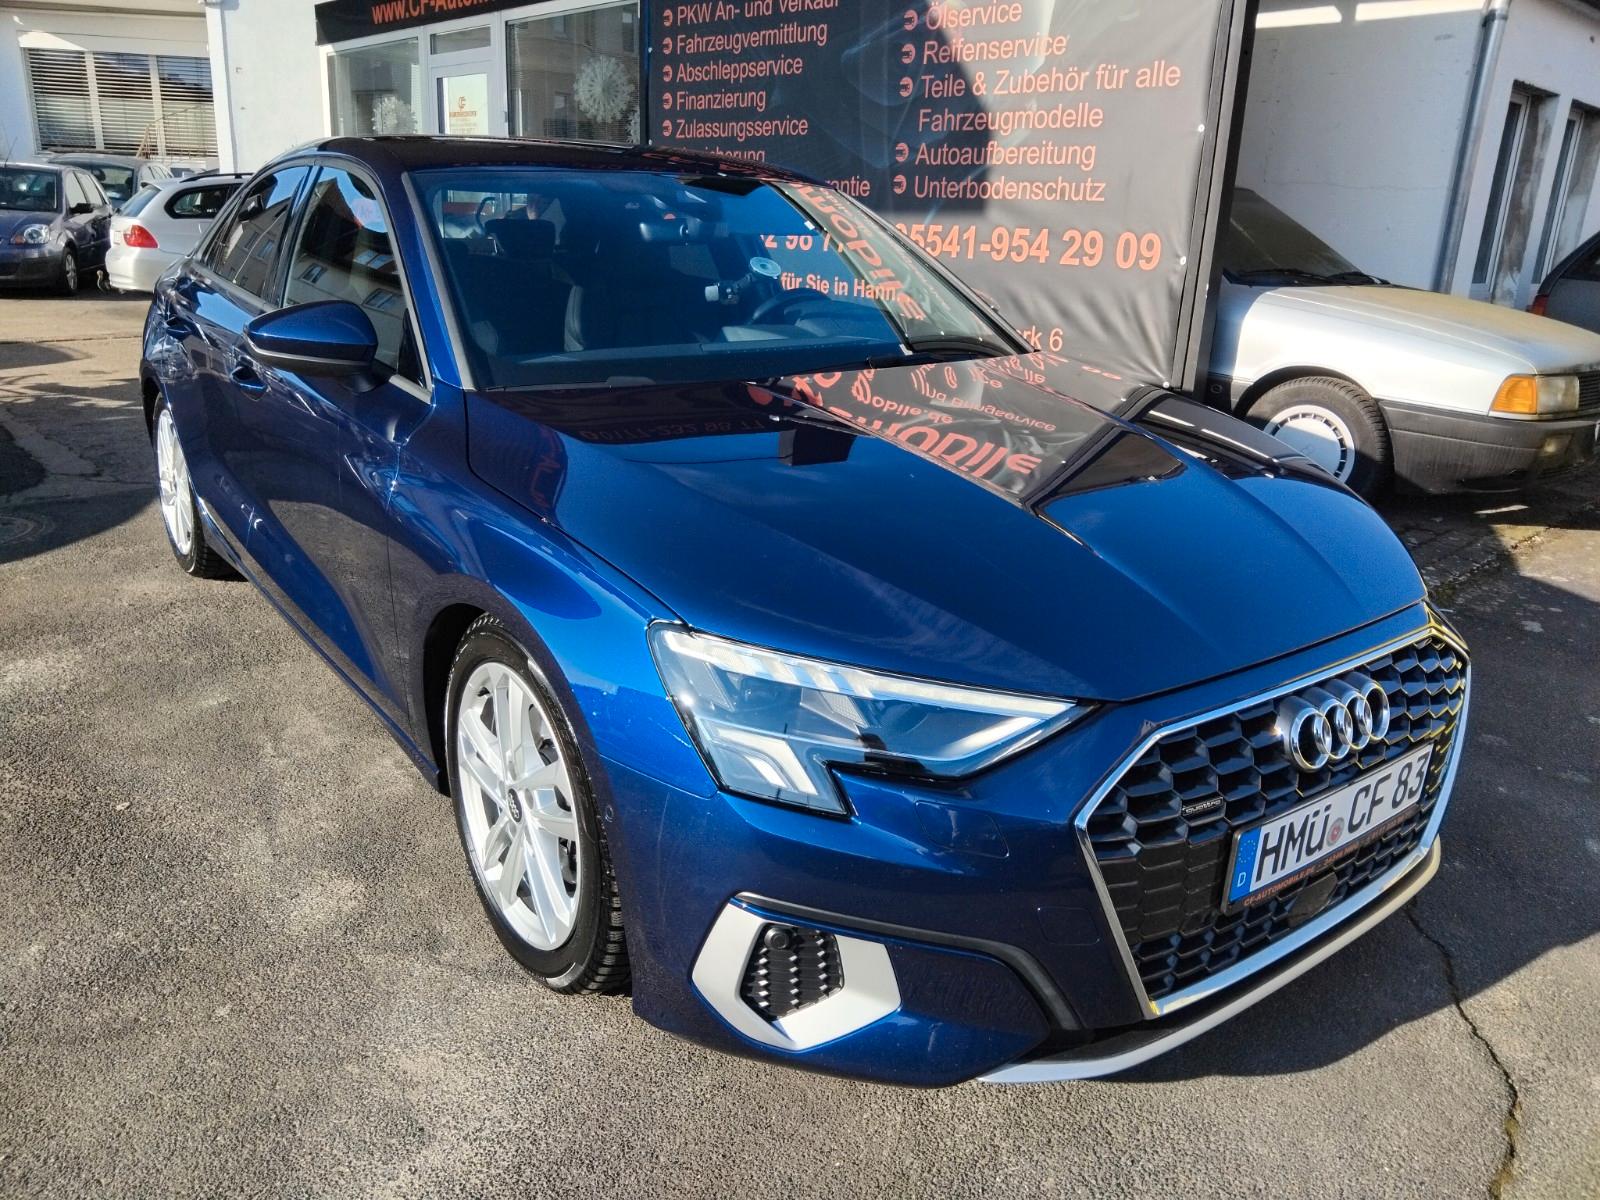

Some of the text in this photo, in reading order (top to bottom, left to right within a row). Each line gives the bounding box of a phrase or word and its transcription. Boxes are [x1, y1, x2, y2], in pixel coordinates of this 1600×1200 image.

[677, 4, 711, 26] PKW
[714, 2, 741, 21] An-
[744, 0, 772, 18] und
[926, 0, 1023, 30] Ölservice
[676, 22, 828, 55] Fahrzeugvermittlung
[922, 32, 1067, 65] Reifenservice
[676, 54, 803, 84] Abschleppservice
[921, 60, 1181, 99] Teile & Zubehör für alle
[676, 88, 766, 112] Finanzierung
[675, 115, 809, 142] Zulassungsservice
[918, 102, 1103, 136] Fahrzeugmodelle
[914, 140, 1097, 171] Autoaufbereitung
[914, 175, 1106, 202] Unterbodenschutz
[1060, 229, 1104, 267] 29
[1115, 231, 1162, 271] 09
[780, 272, 803, 291] für
[806, 273, 830, 295] Sie
[834, 275, 849, 296] in
[1049, 327, 1064, 352] 6
[1255, 804, 1332, 883] HMÜ
[1347, 772, 1393, 834] CF
[1391, 751, 1431, 810] 83
[1237, 871, 1247, 888] D
